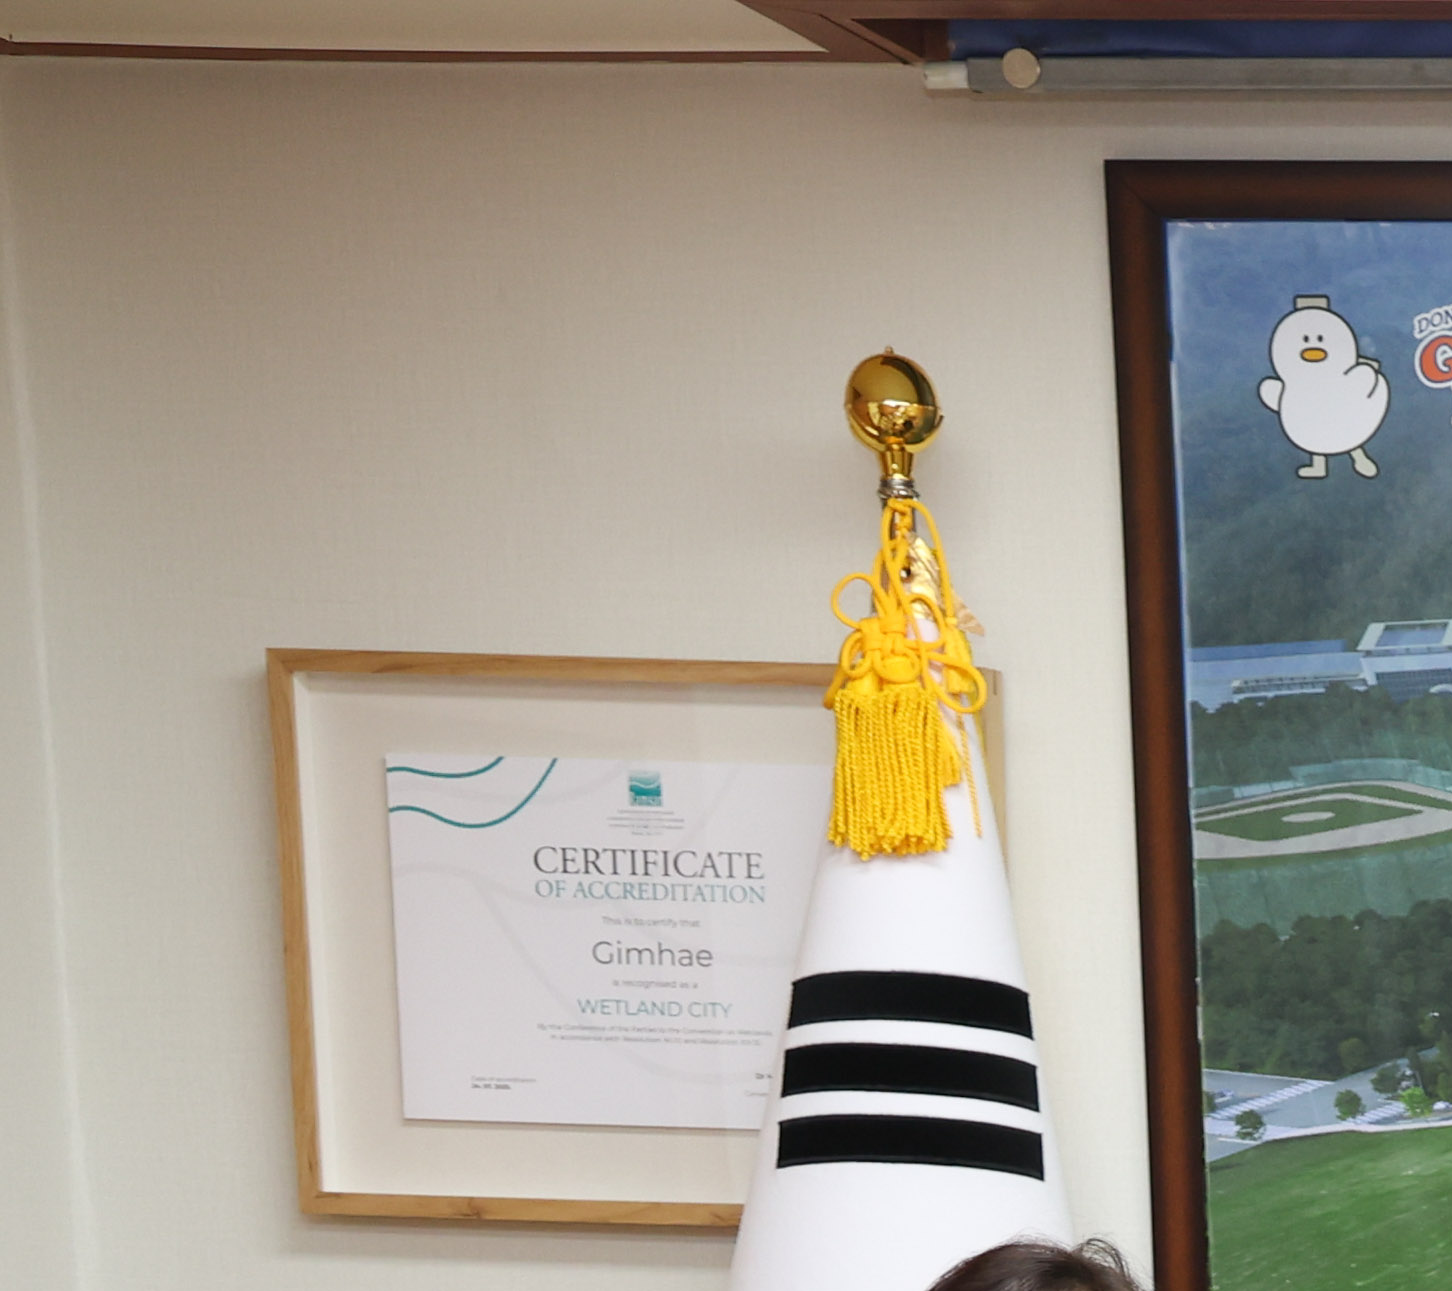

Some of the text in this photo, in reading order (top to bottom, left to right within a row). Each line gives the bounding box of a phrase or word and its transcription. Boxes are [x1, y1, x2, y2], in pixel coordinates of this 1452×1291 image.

[533, 845, 764, 880] CERTIFICATE
[535, 879, 765, 903] OF ACCREDITATION
[592, 940, 713, 967] Gimhae
[577, 998, 732, 1019] WETLAND CITY
